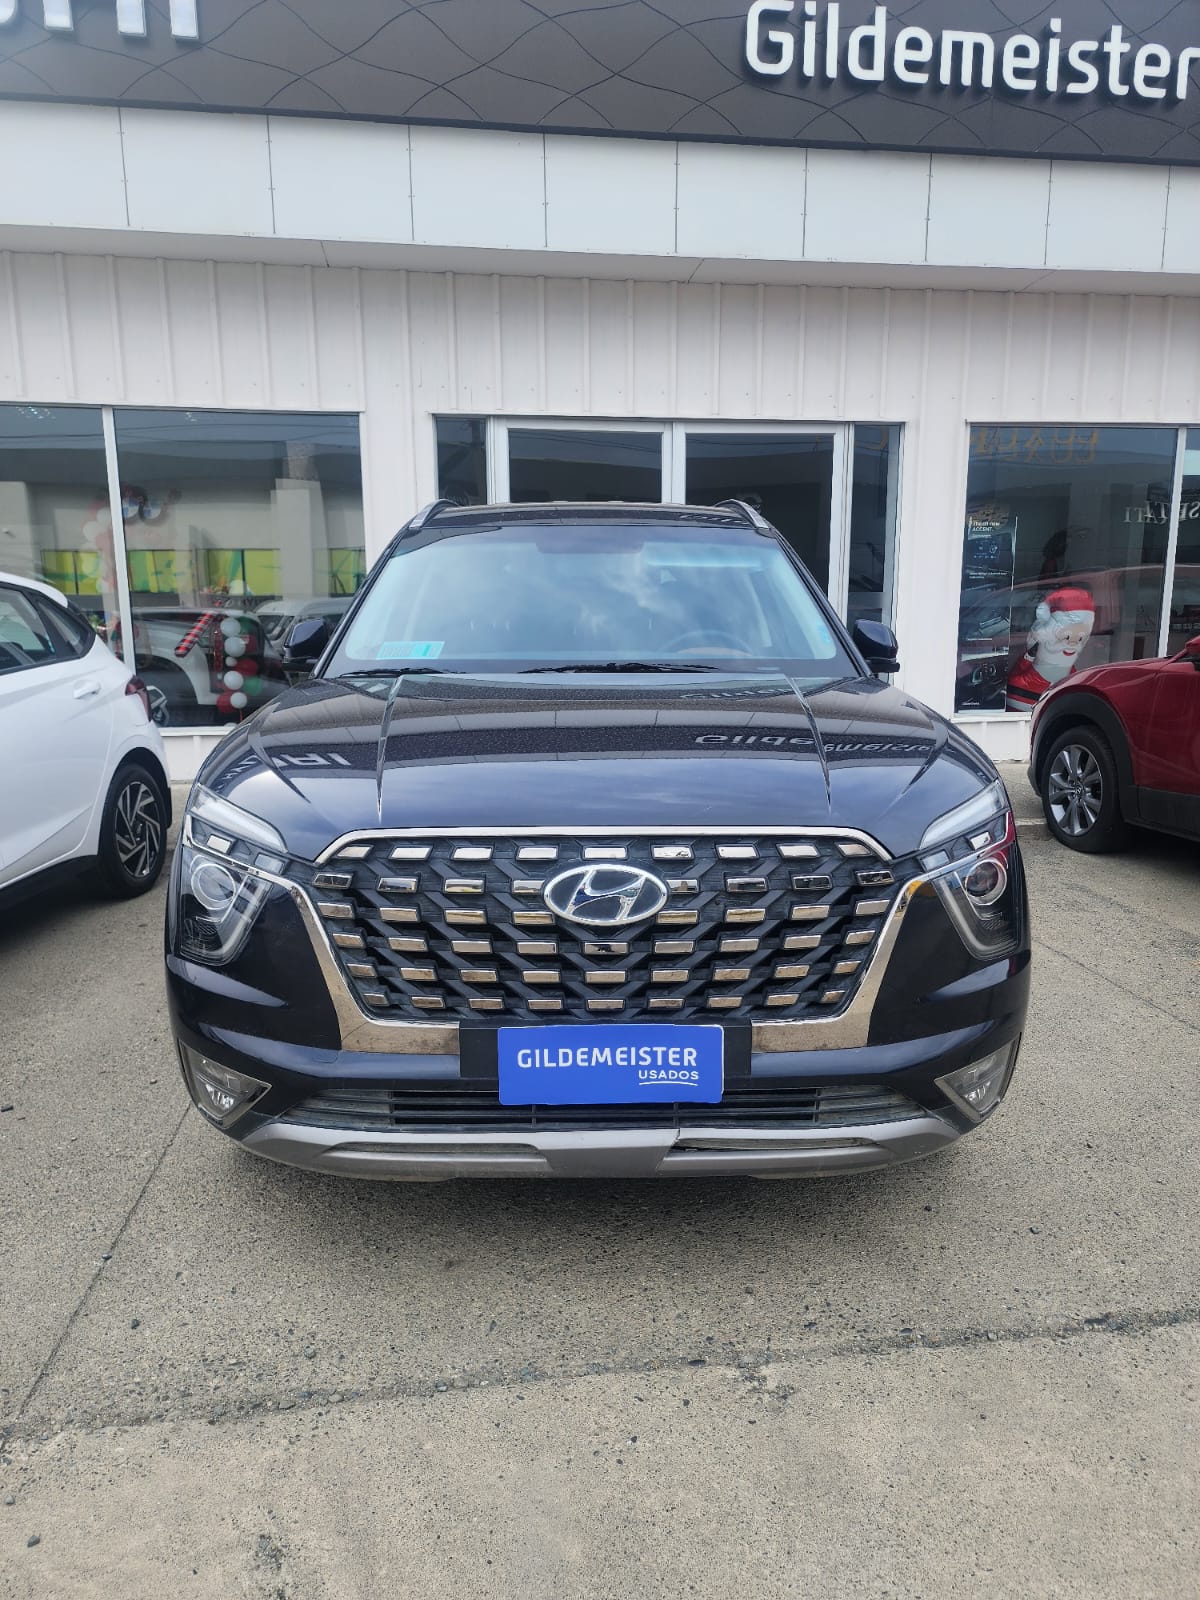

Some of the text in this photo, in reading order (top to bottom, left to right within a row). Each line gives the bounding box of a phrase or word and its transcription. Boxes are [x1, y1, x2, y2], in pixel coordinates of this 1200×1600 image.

[745, 0, 1200, 100] Gildemeister
[517, 1046, 698, 1069] GILDEMEISTER
[638, 1070, 699, 1080] USADOS
